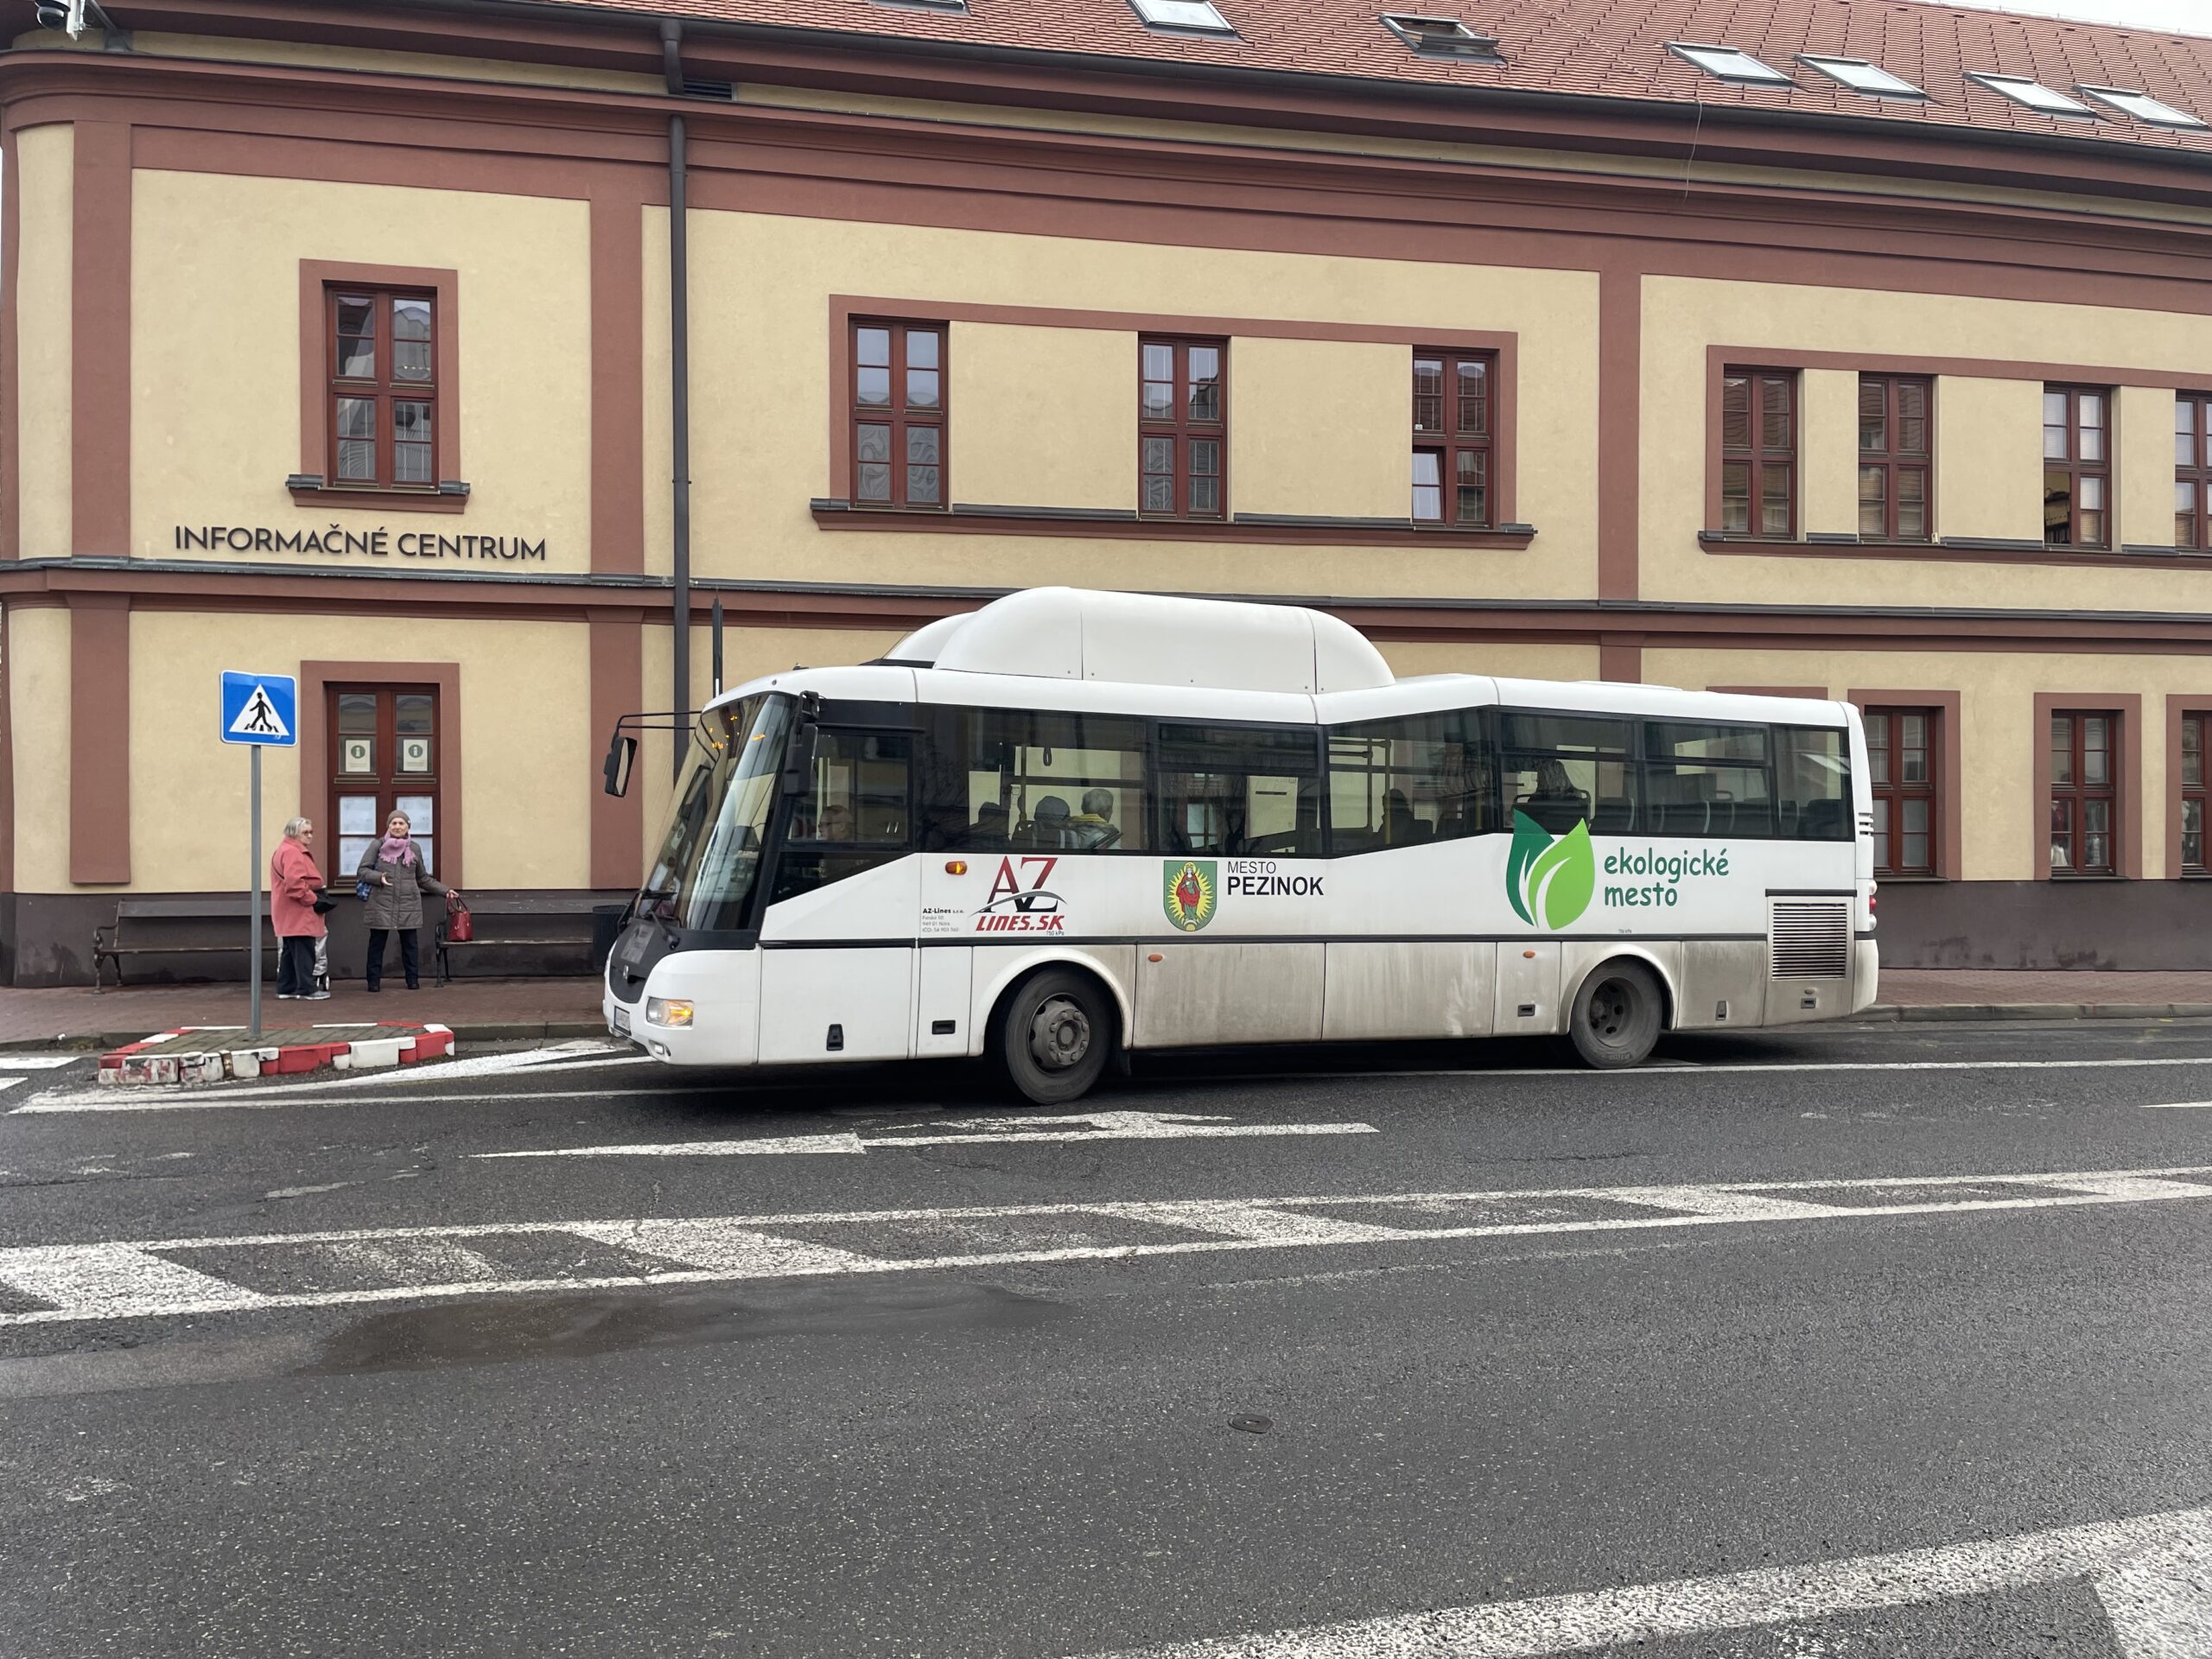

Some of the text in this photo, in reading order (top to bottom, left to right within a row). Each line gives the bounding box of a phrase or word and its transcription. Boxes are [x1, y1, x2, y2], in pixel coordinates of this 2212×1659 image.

[175, 524, 546, 561] INFORMAČNÉ CENTRUM
[1228, 861, 1276, 874] MESTO
[1605, 847, 1729, 883] ekologické
[1228, 876, 1324, 896] PEZINOK
[1605, 882, 1678, 907] mesto
[976, 914, 1065, 931] LINES.SK
